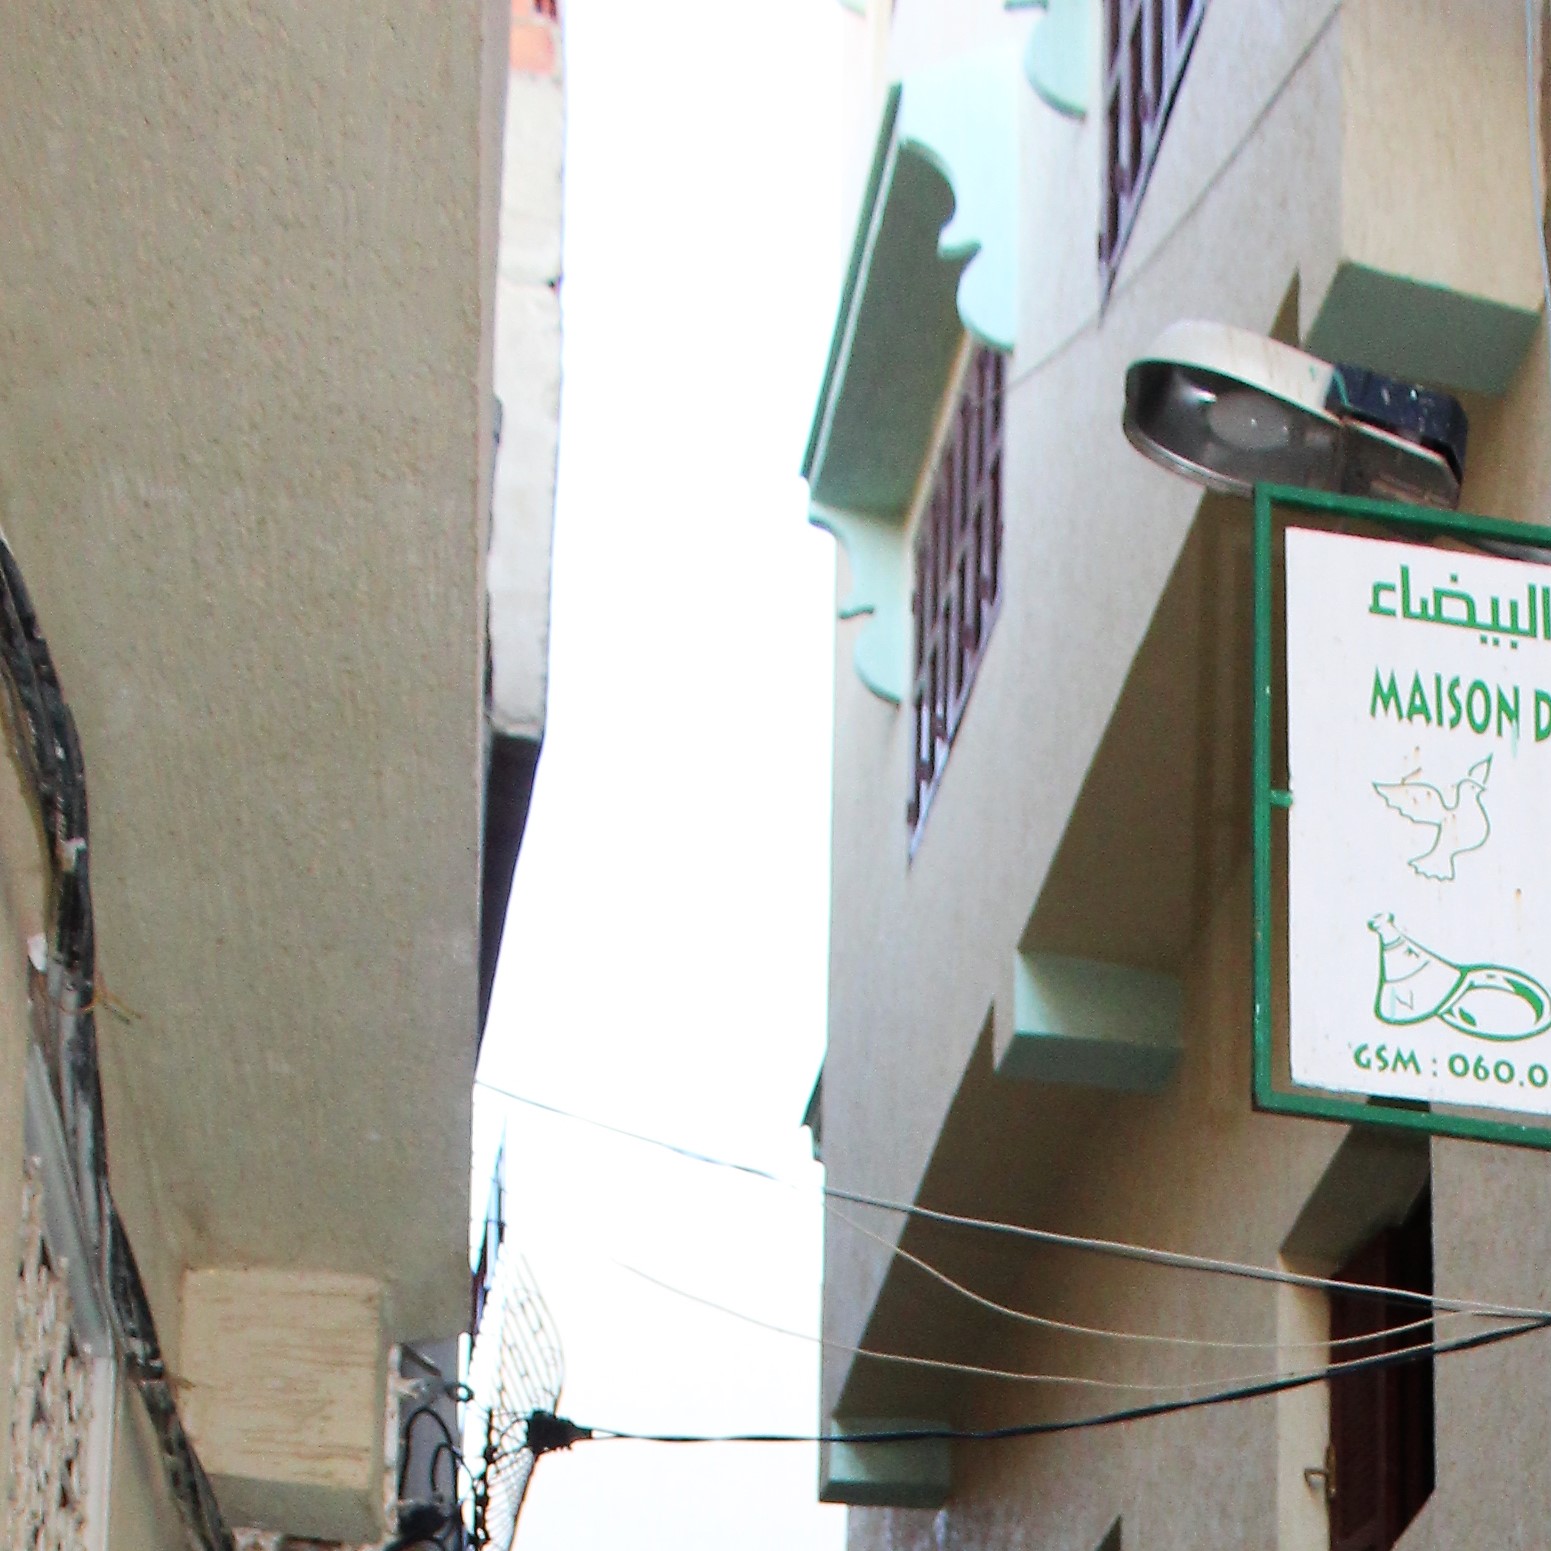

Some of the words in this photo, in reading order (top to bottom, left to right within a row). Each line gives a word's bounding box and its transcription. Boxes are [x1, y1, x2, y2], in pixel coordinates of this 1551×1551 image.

[1369, 564, 1551, 649] البيضاء
[1369, 666, 1519, 737] MAISON
[1353, 1043, 1422, 1075] GSM
